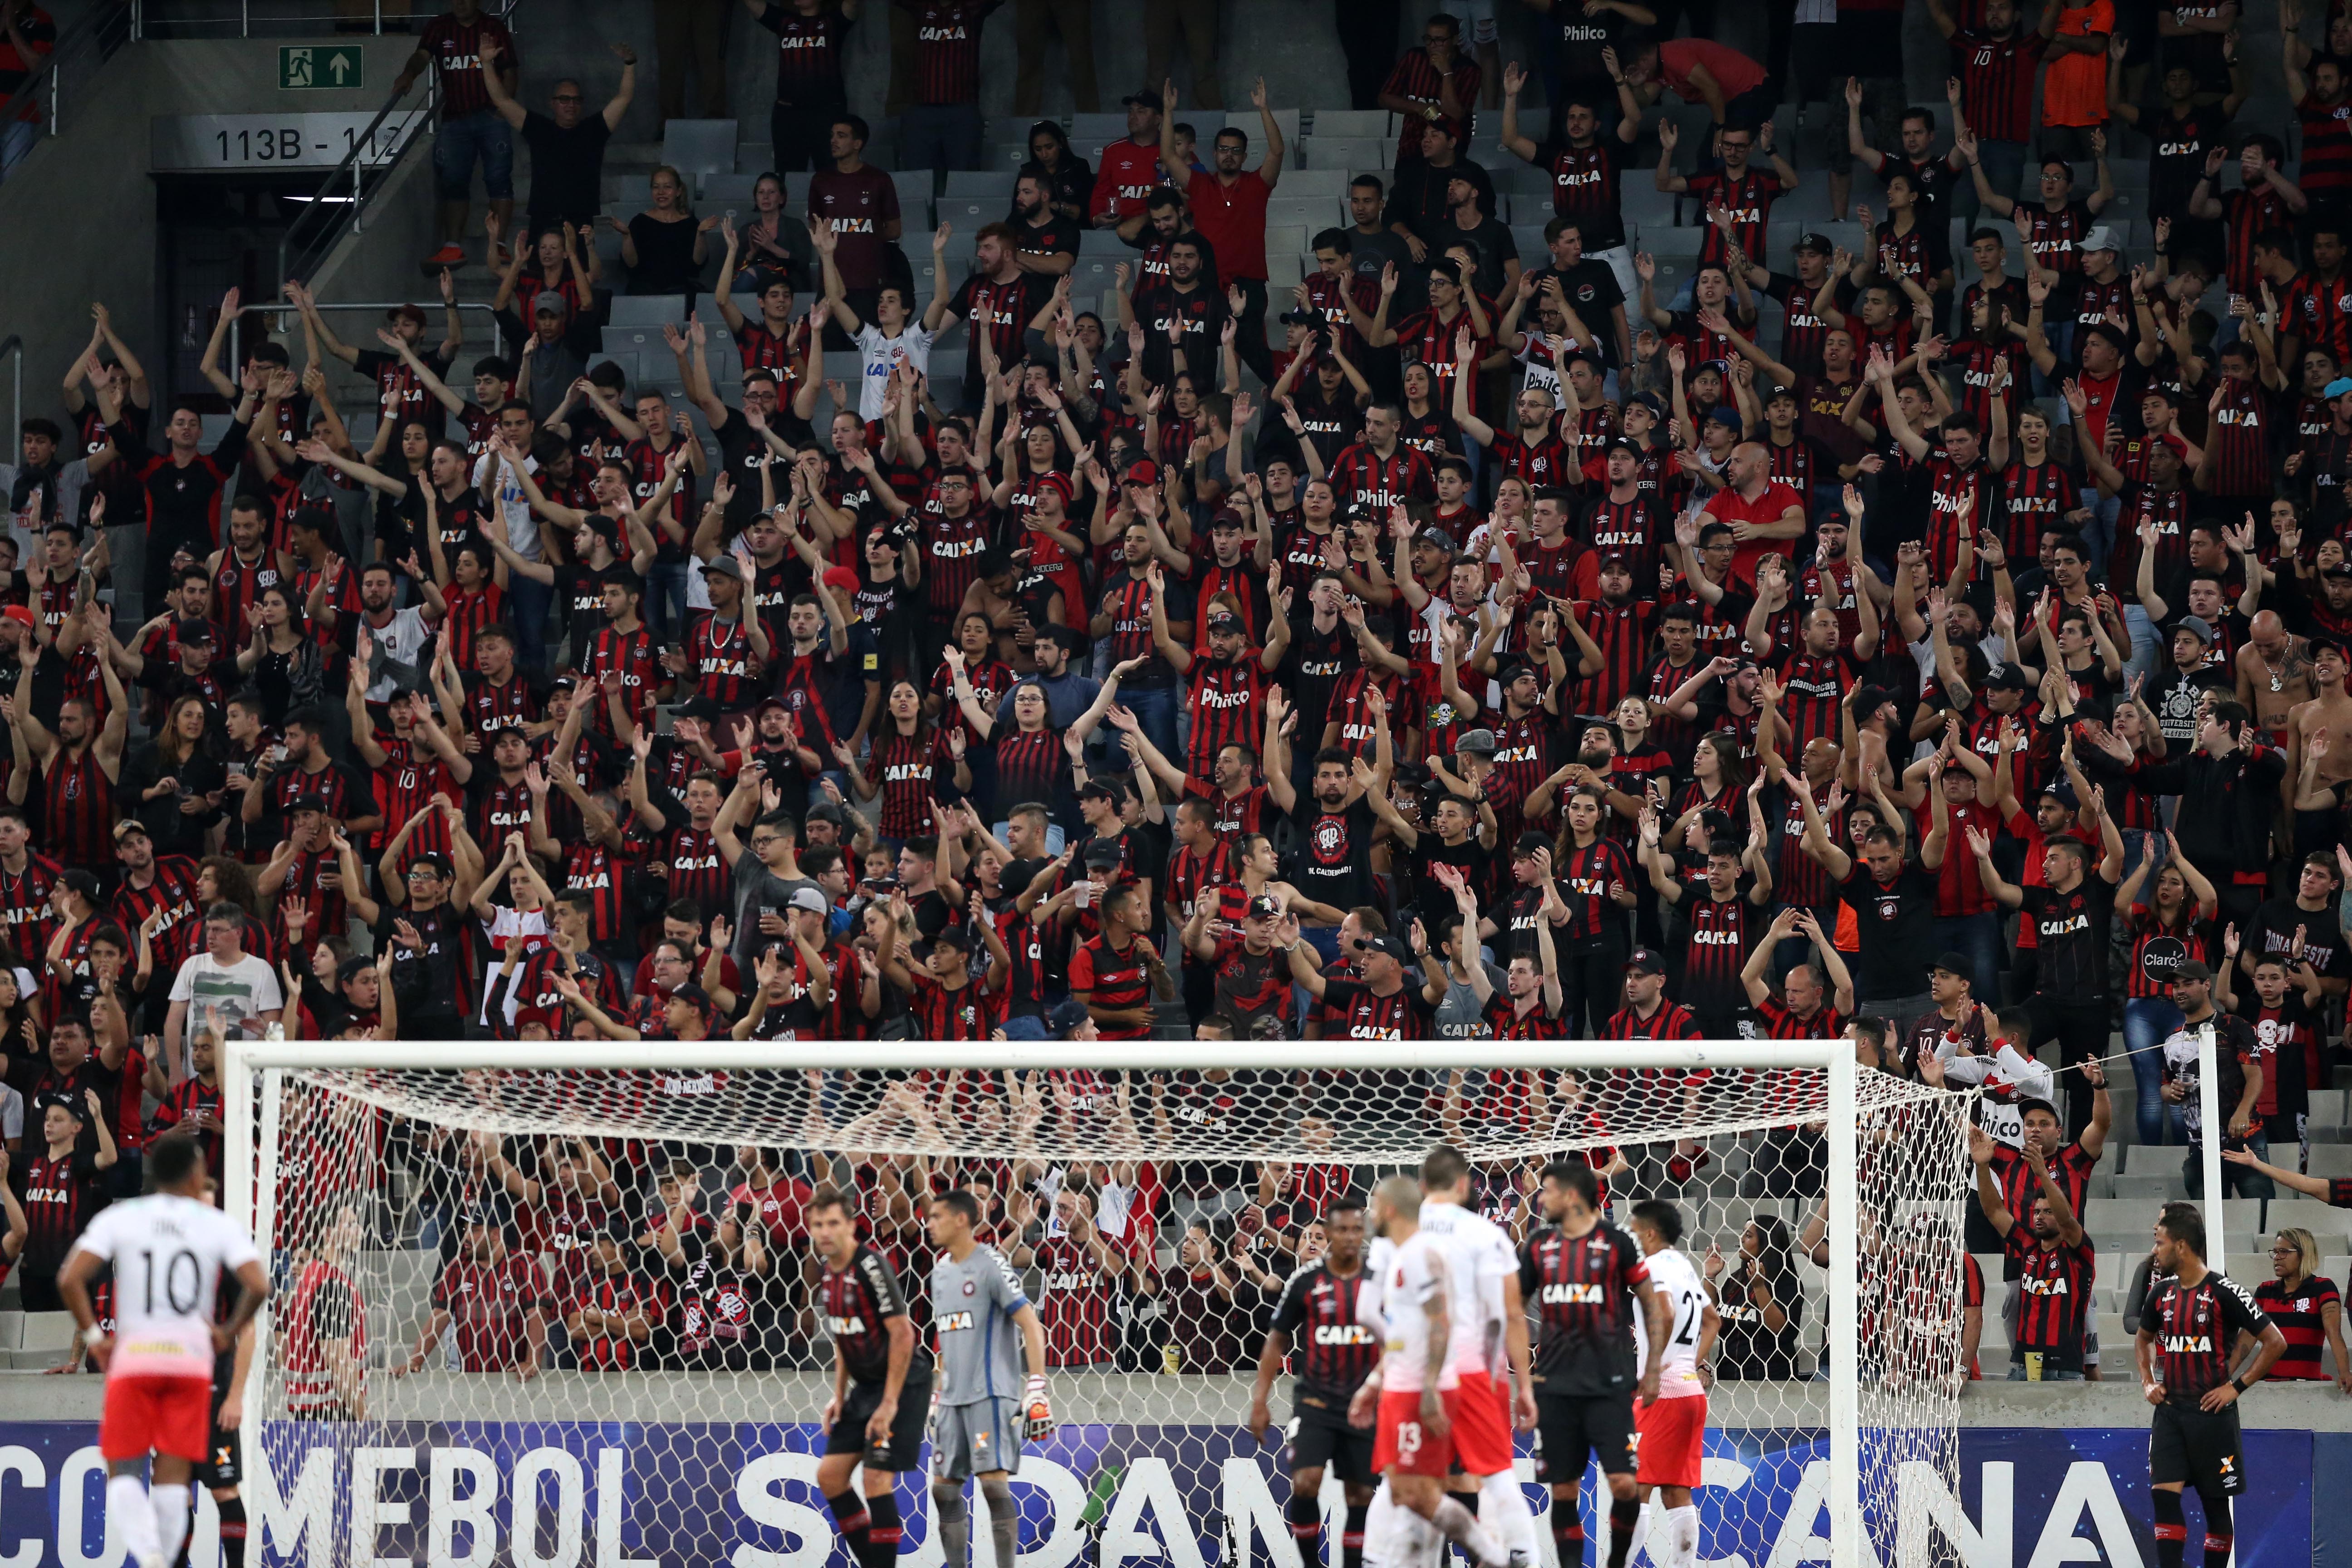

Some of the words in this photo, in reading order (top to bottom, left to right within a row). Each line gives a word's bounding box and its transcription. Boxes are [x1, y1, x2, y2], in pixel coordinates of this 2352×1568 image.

[920, 25, 966, 41] CAIXA
[1564, 25, 1606, 41] Philco
[781, 36, 826, 49] CAIXA
[443, 55, 482, 70] CAIX
[1974, 50, 1990, 66] 10
[218, 129, 301, 161] 113B
[2160, 140, 2200, 156] CAIXA
[1118, 185, 1154, 199] CAIX
[831, 218, 873, 233] AIXA
[2032, 239, 2072, 254] CAIXA
[1154, 317, 1204, 333] CAXA
[1525, 372, 1561, 397] Philc
[2218, 409, 2259, 427] AIXA
[1303, 421, 1341, 432] CAIXA
[1578, 434, 1606, 446] IXA
[581, 445, 622, 458] CAXA
[1010, 493, 1038, 506] CAI
[2007, 497, 2056, 513] CAIXA
[441, 529, 466, 544] IXA
[1595, 532, 1642, 545] CAIXA
[933, 537, 985, 558] CAIXA
[1288, 551, 1326, 568] CAIX
[574, 596, 605, 610] CAIX
[1408, 628, 1432, 643] CAI
[1696, 624, 1735, 640] AIXA
[1816, 689, 1837, 697] com.br
[1343, 723, 1377, 740] CAIX
[2161, 720, 2196, 729] UNIVERSIT
[1975, 736, 2029, 754] CAIA
[398, 770, 415, 789] 10
[6, 902, 53, 924] AIXA
[2040, 914, 2089, 936] CAIXA
[1694, 930, 1738, 945] CAIXA
[2264, 929, 2291, 953] ZONA
[2144, 952, 2179, 967] Claro
[1351, 1025, 1401, 1041] CAIXA
[1442, 1023, 1493, 1037] CAIXA
[143, 1250, 201, 1315] 10
[1049, 1272, 1105, 1291] CAIXA
[1543, 1283, 1604, 1305] CAIXA
[2218, 1277, 2263, 1321] HAVAN
[1675, 1290, 1702, 1346] 2
[0, 1445, 641, 1568] COMEBOL
